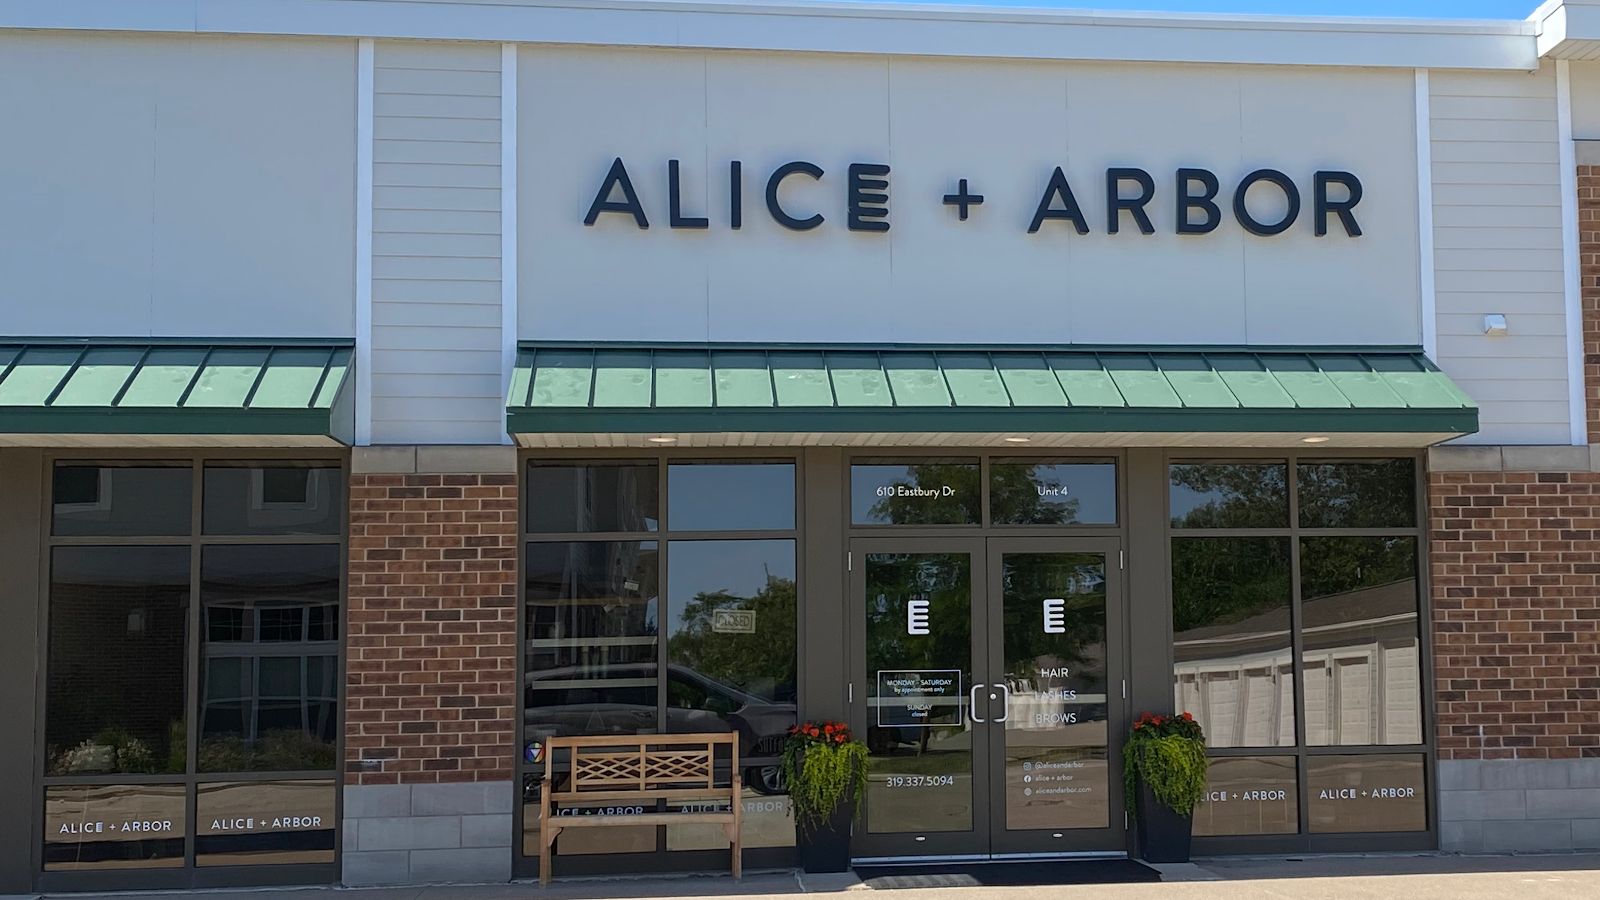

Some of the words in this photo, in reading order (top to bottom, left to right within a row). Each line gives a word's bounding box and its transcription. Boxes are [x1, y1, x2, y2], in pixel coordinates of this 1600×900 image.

[584, 157, 891, 232] ALICE
[943, 178, 984, 221] +
[1027, 165, 1363, 238] ARBOR
[876, 486, 895, 497] 610
[897, 485, 940, 500] Eastbury
[942, 486, 956, 497] Dr
[1037, 486, 1058, 497] Unit
[1060, 486, 1068, 497] 4
[718, 615, 749, 626] CLOSED
[1041, 667, 1069, 678] HAIR
[1035, 690, 1076, 701] LASHES
[1036, 713, 1077, 723] BROWS
[1035, 761, 1084, 770] @aliceandarbor
[887, 775, 953, 787] 319.337.5094
[1035, 786, 1092, 795] aliceandarbor.com
[1243, 790, 1285, 801] ARBOR
[1319, 788, 1356, 799] ALICE
[1372, 787, 1414, 798] ARBOR
[60, 822, 103, 834] ALICE
[121, 820, 172, 832] ARBOR
[211, 818, 253, 830] ALICE
[271, 816, 321, 828] ARBOR
